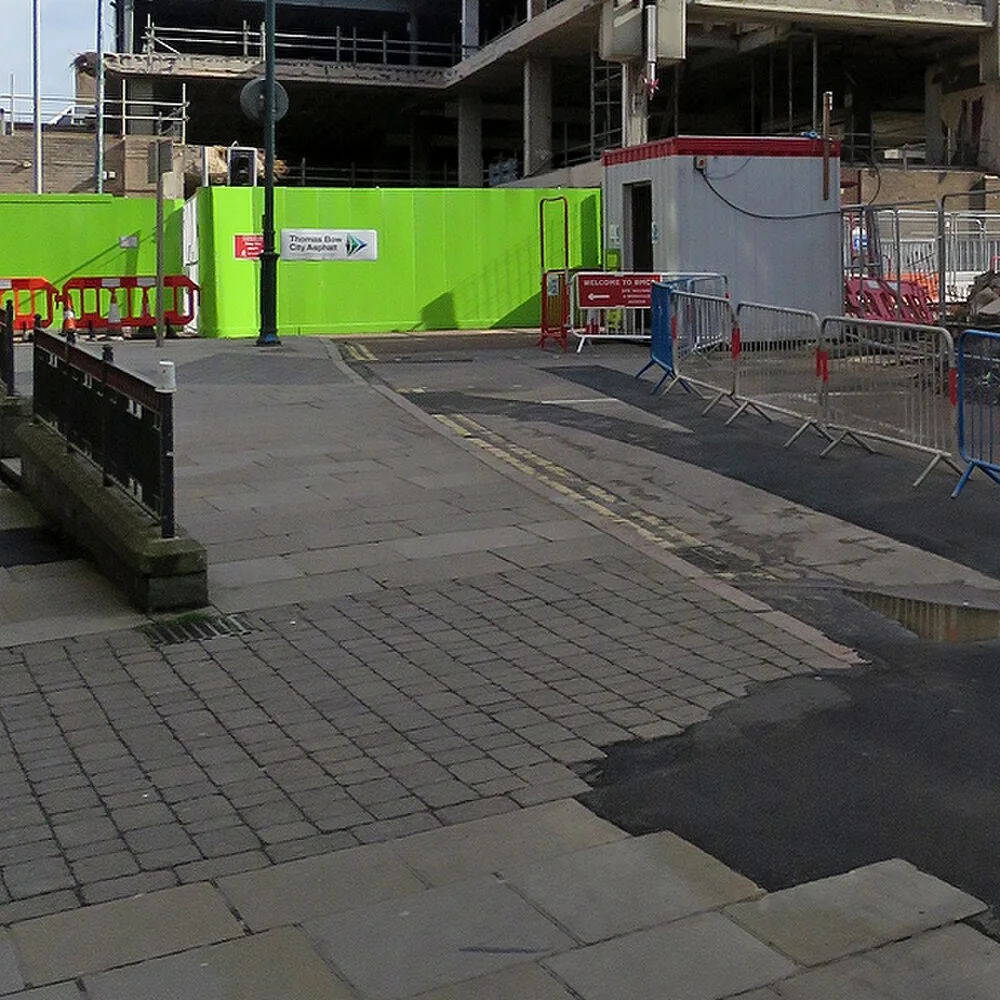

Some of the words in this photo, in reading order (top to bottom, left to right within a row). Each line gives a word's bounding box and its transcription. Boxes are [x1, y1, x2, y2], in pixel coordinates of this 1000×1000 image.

[289, 234, 322, 243] Thomas
[289, 243, 305, 252] City
[306, 243, 337, 252] Asphalt
